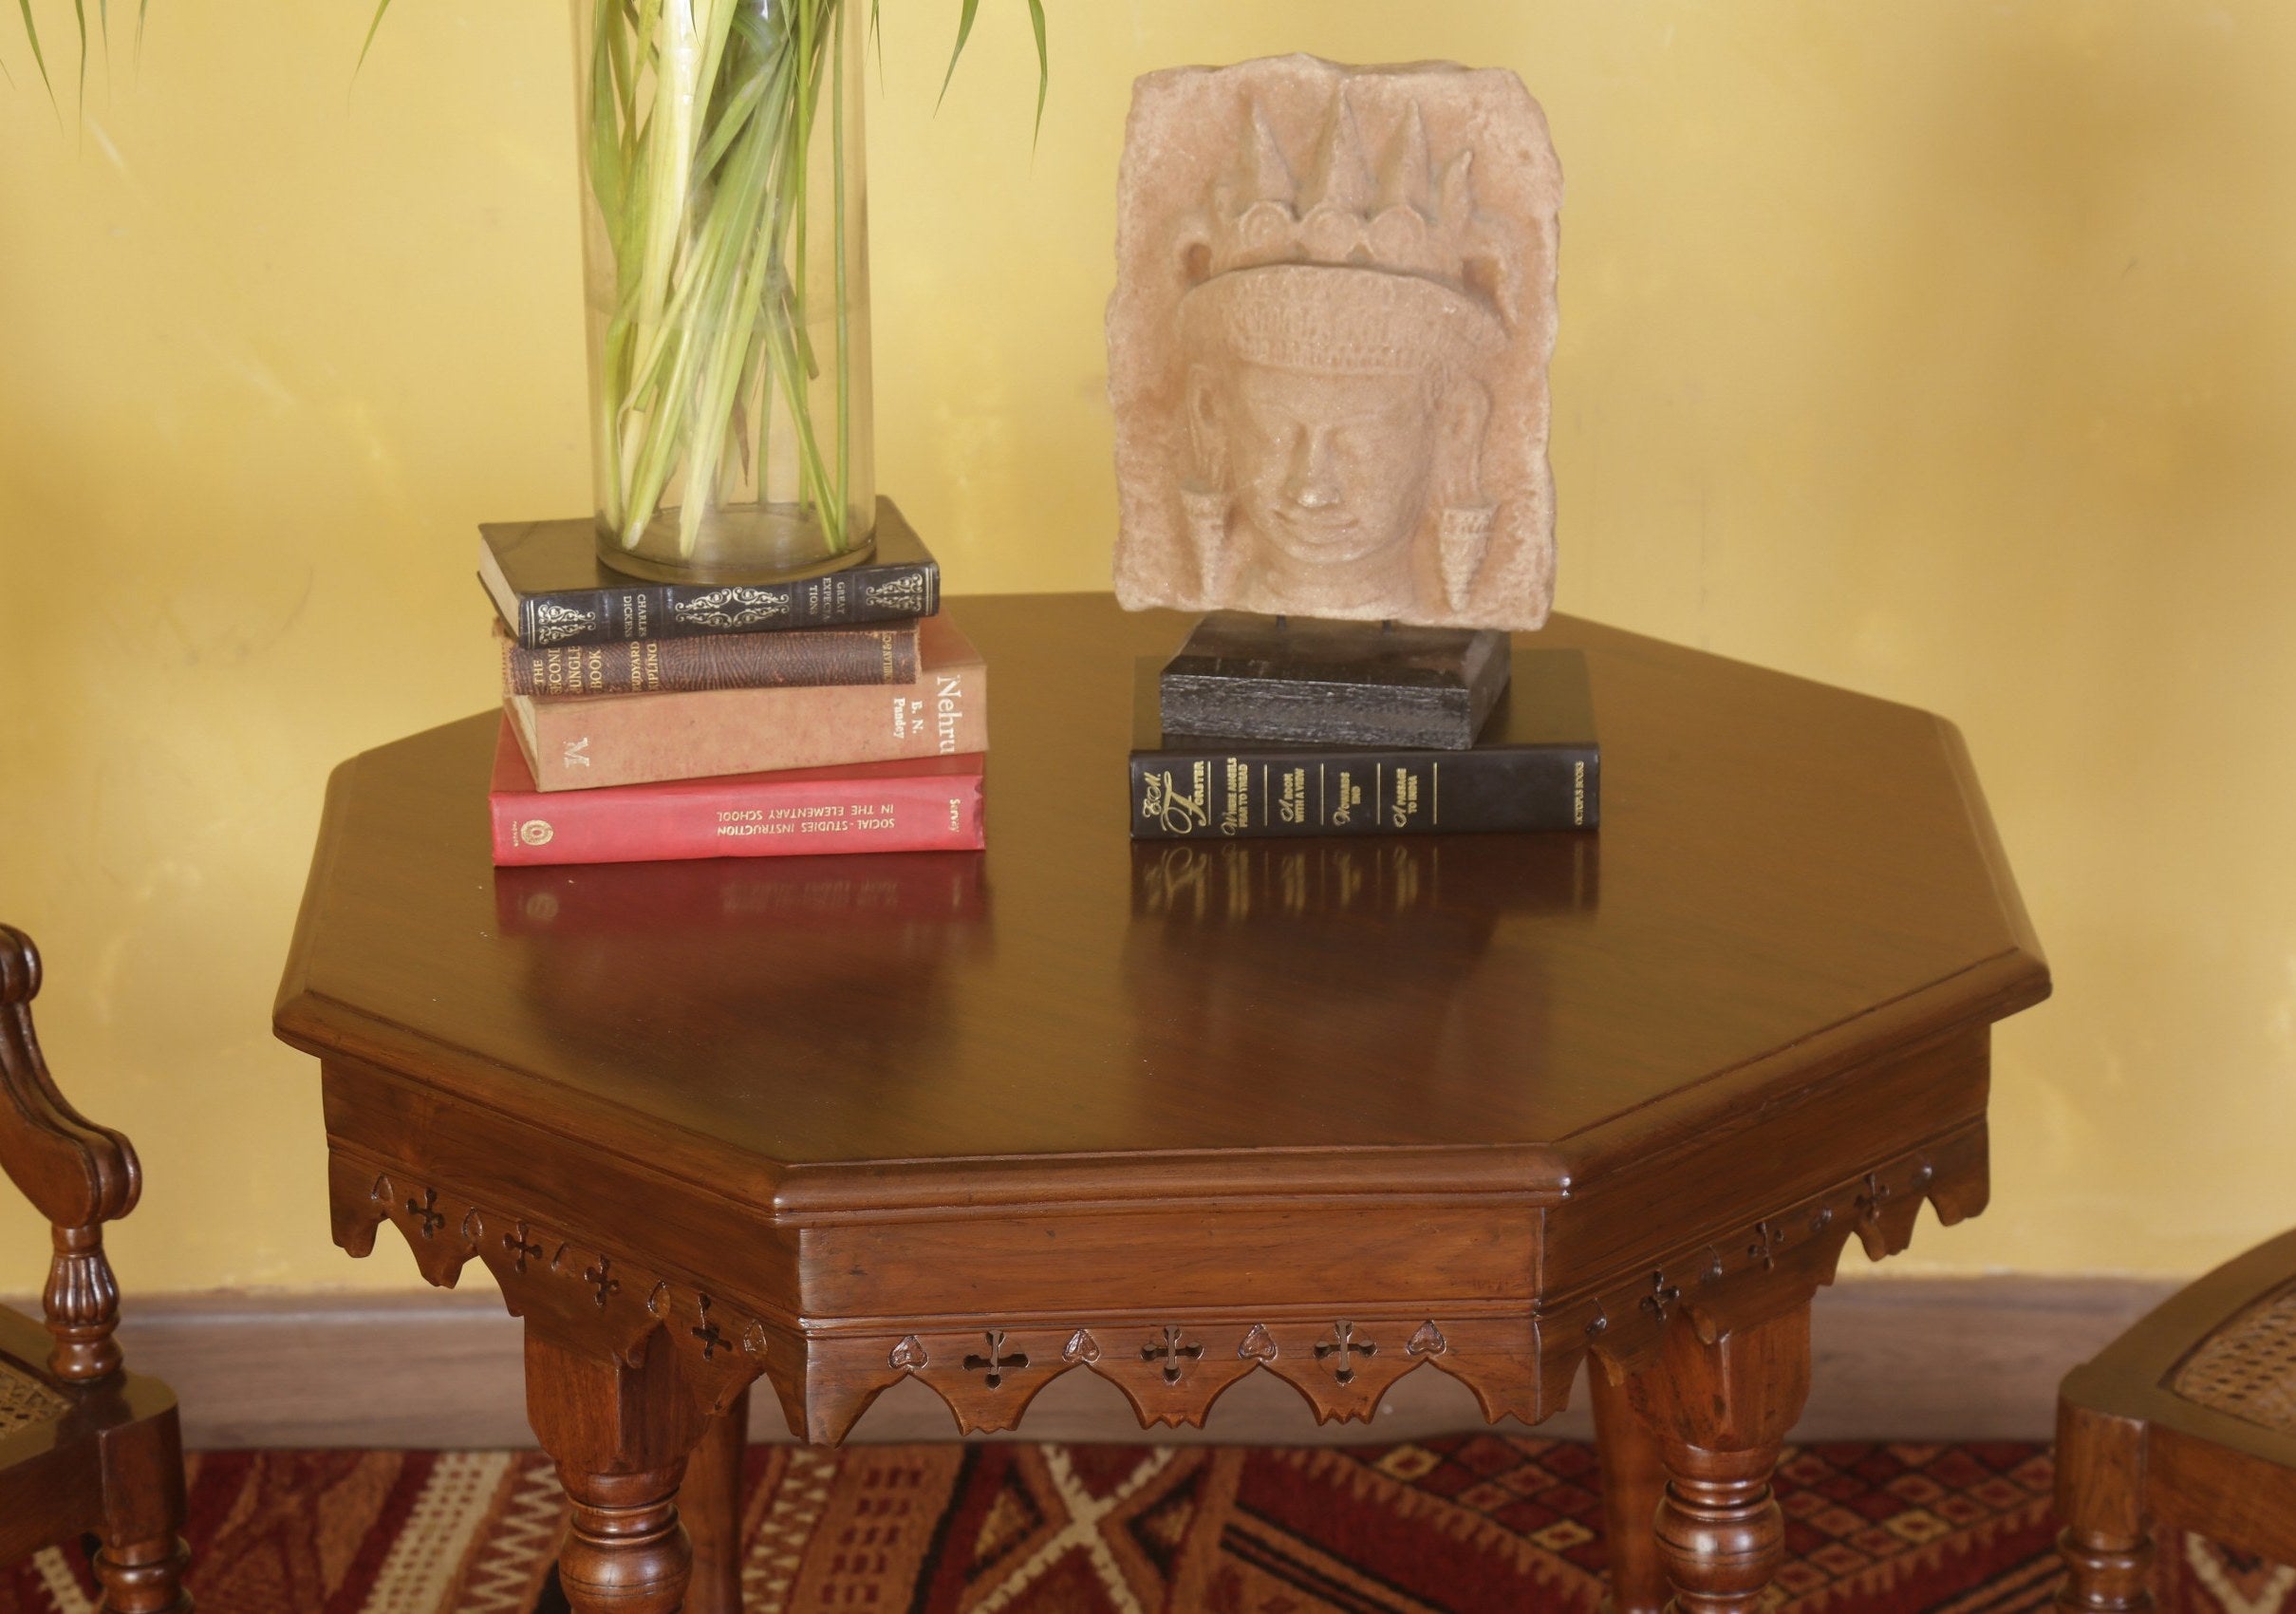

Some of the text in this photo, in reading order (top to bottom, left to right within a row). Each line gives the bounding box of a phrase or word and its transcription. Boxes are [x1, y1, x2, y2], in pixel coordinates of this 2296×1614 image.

[623, 595, 633, 638] DICKENS
[637, 593, 647, 638] CHARLES
[533, 659, 544, 685] THE
[589, 649, 603, 689] BOOK
[630, 641, 643, 693] RUDYARD
[893, 696, 906, 739] Pandey
[912, 719, 924, 734] N.
[936, 673, 962, 755] Nehru
[1238, 793, 1248, 806] TO
[1295, 791, 1305, 799] A
[717, 804, 894, 822] IN THE ELEMENTARY SCHOOL
[717, 823, 794, 836] INSTRUCTION
